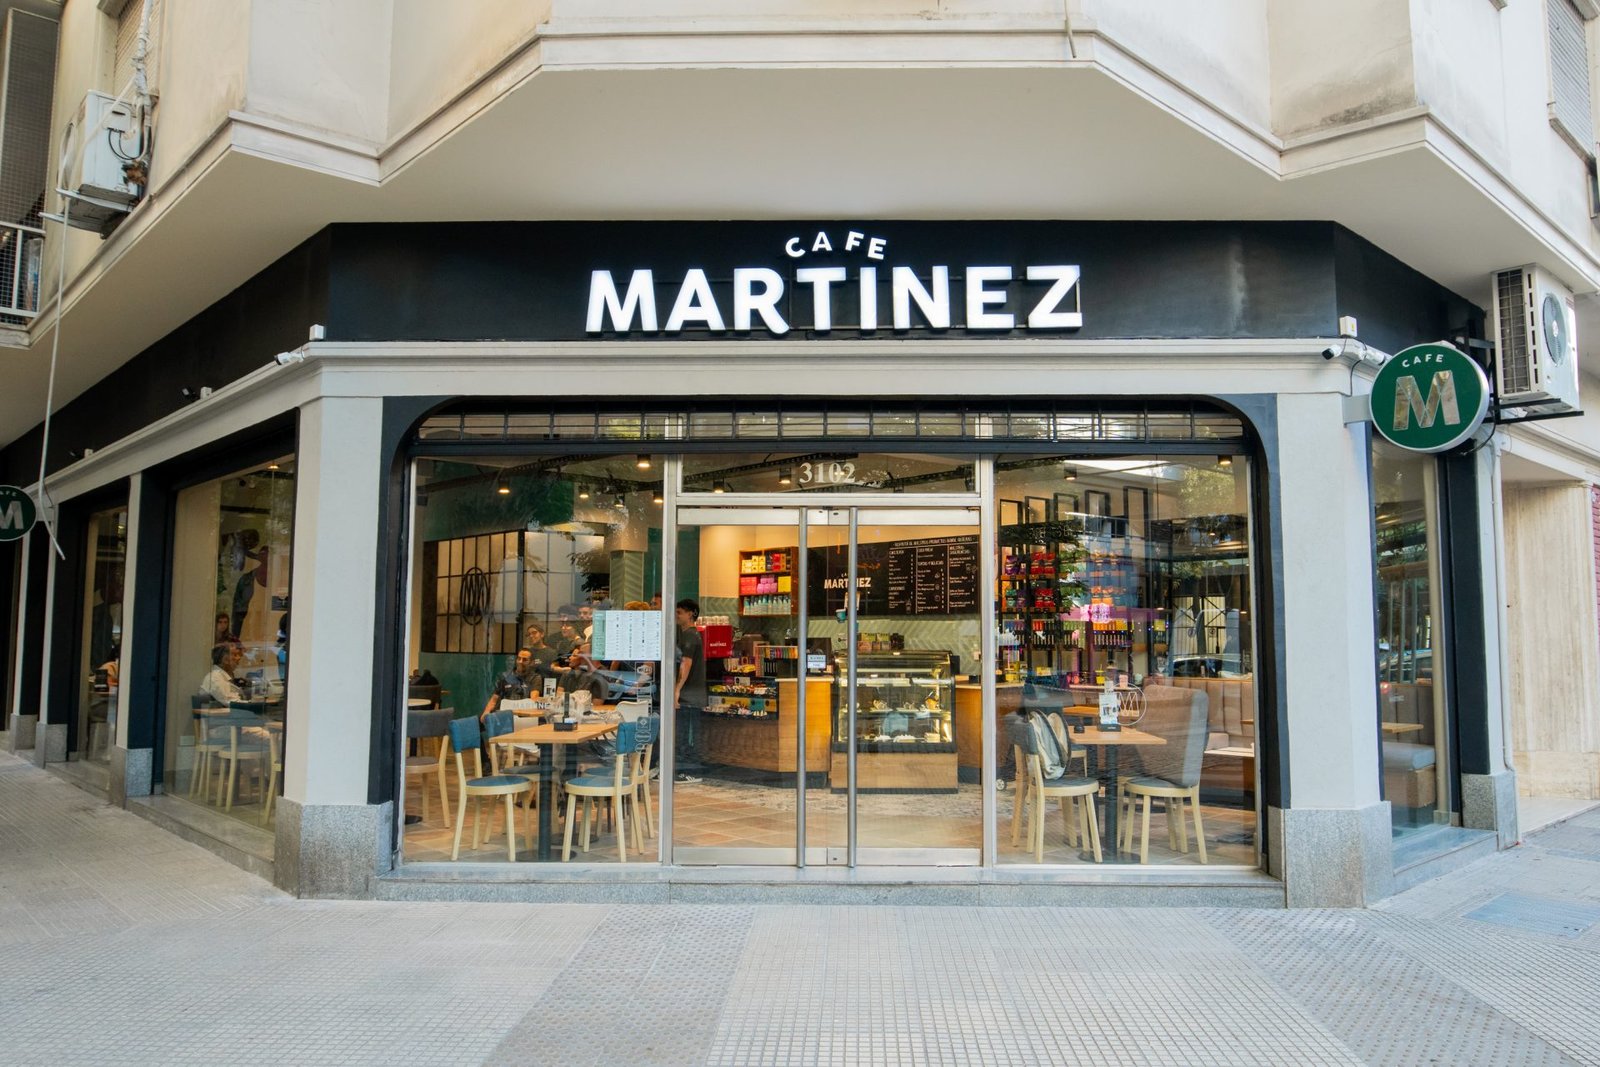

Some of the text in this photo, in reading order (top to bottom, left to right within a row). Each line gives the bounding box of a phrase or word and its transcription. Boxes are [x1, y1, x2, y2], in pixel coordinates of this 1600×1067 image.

[785, 231, 887, 260] CAFE
[585, 265, 1083, 334] MARTINEZ
[1402, 354, 1444, 368] CAFE
[1393, 370, 1460, 431] M
[799, 462, 856, 484] 3102
[824, 577, 872, 589] MARTEZ
